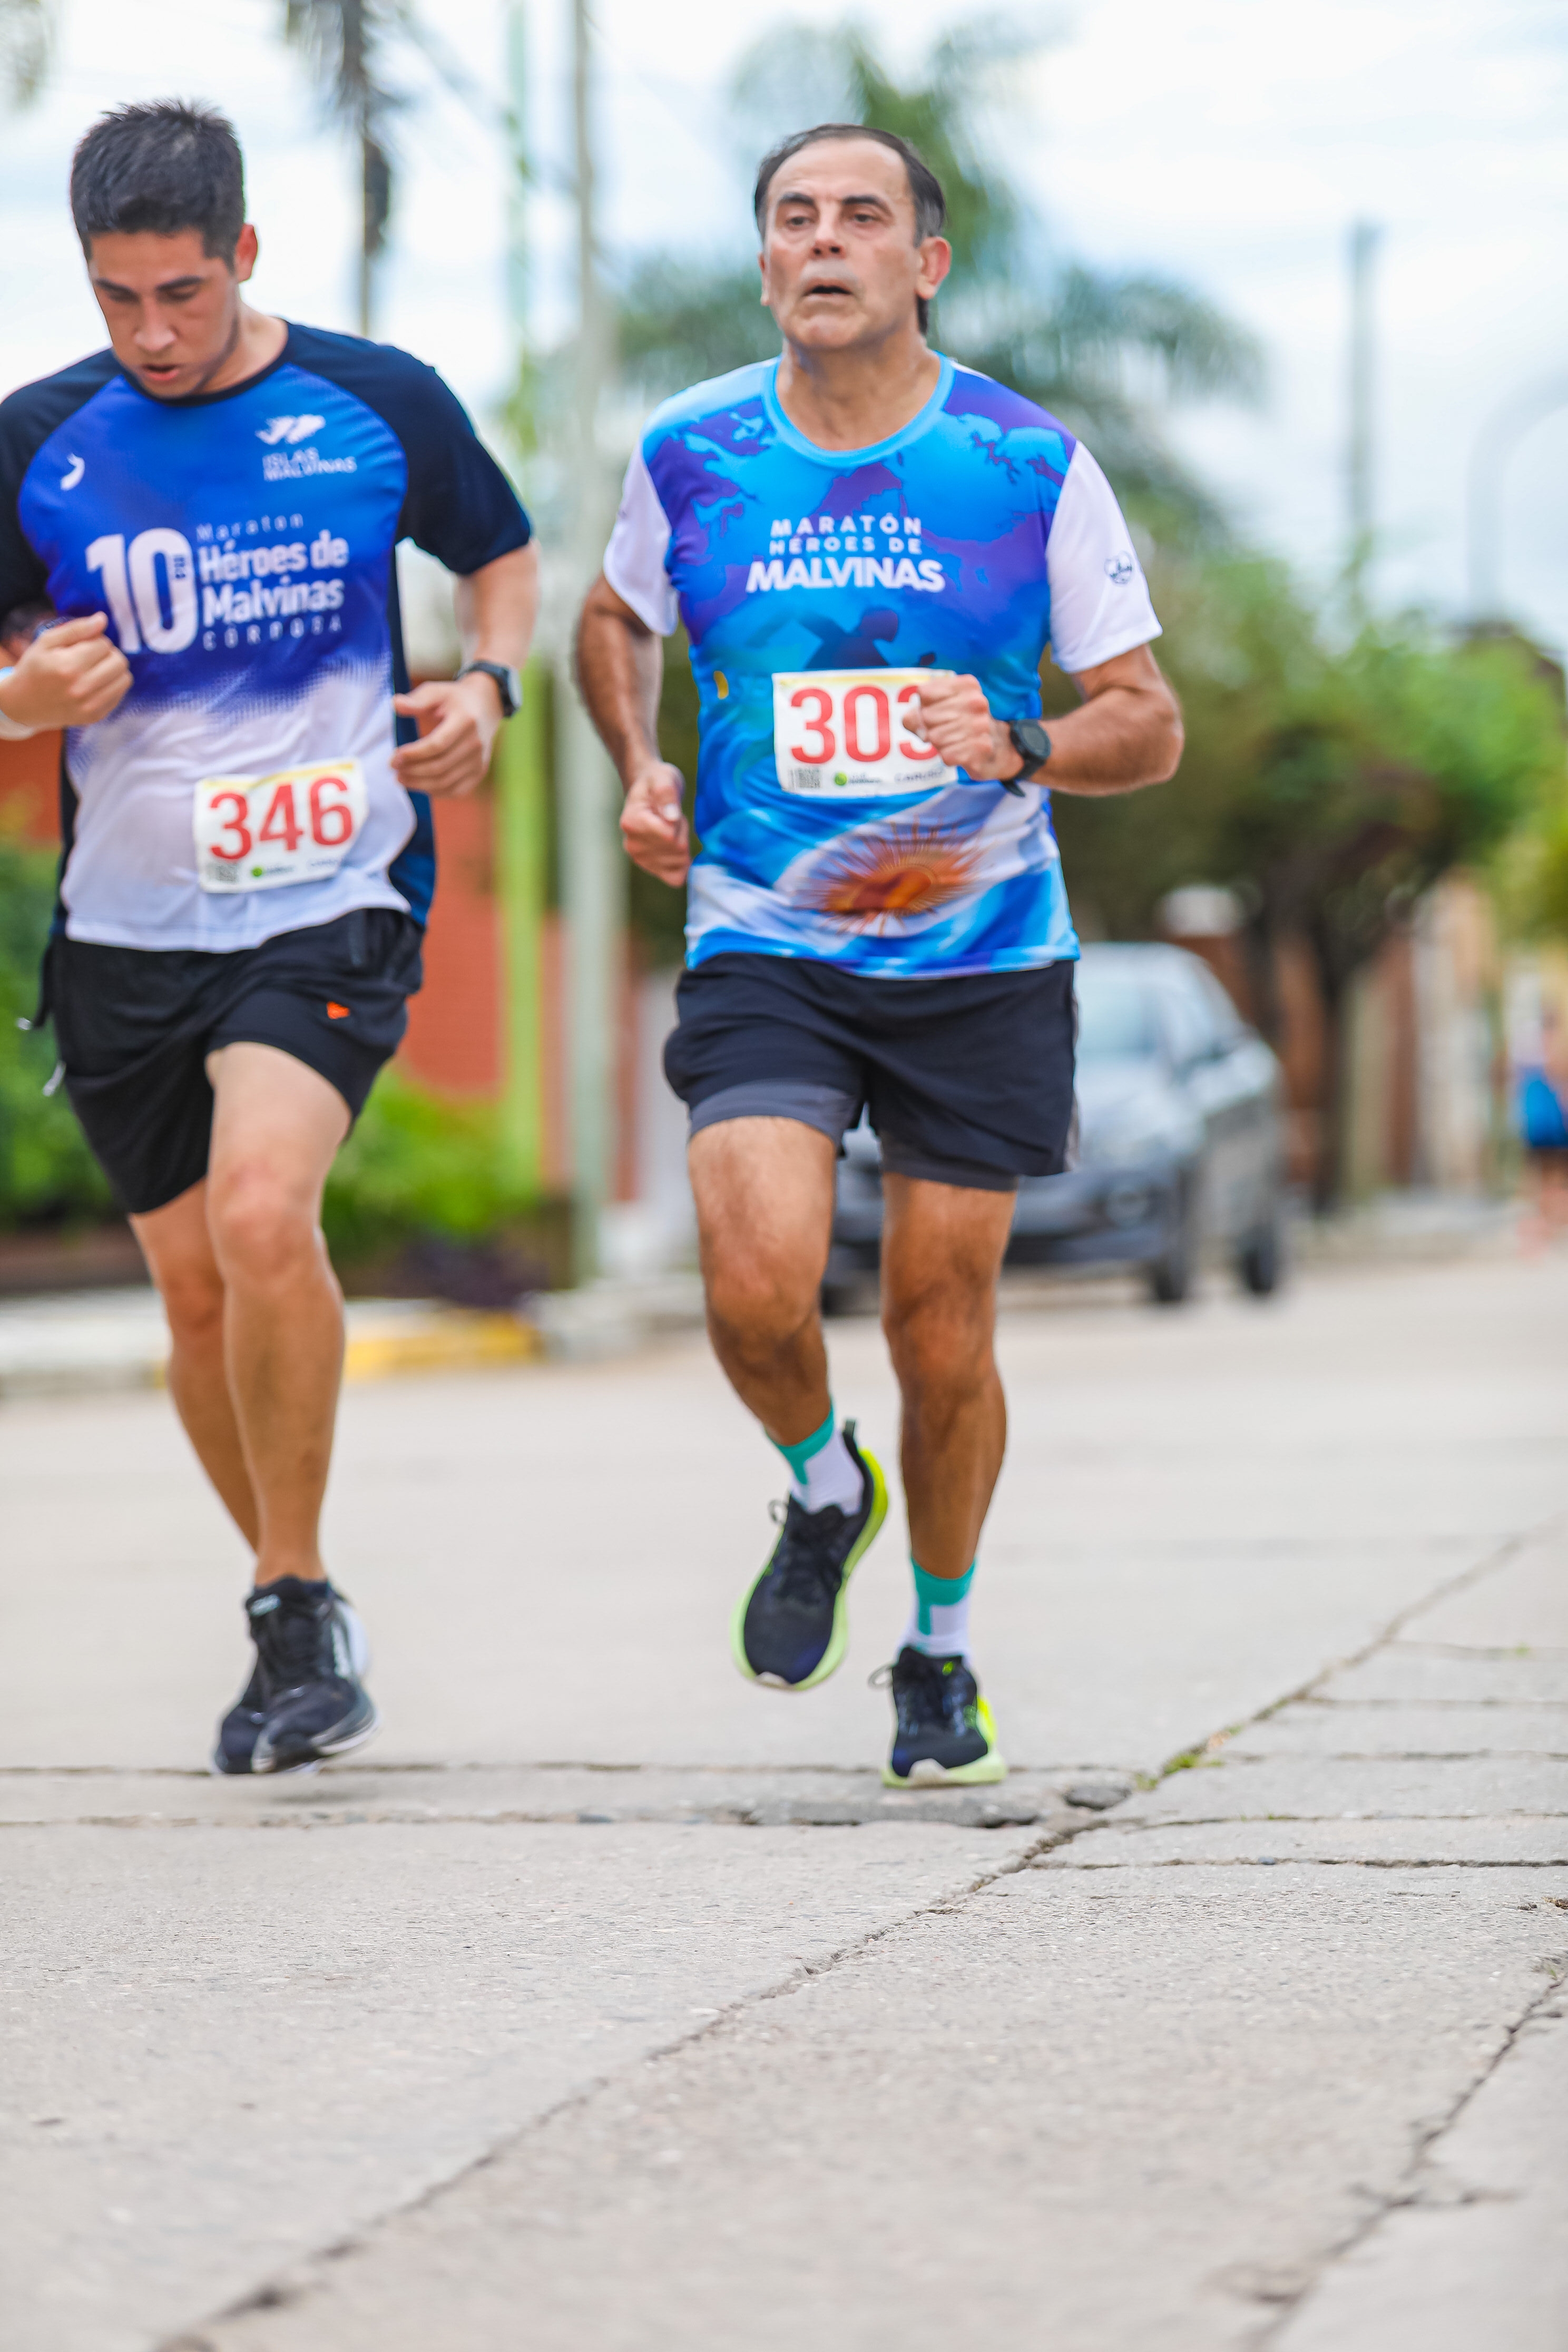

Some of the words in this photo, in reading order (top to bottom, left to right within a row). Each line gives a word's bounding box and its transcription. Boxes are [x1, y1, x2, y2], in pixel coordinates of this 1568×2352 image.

[770, 513, 922, 538] MARATÓN
[889, 537, 922, 555] DE
[198, 538, 308, 583] Héroes
[310, 529, 349, 569] de
[746, 557, 946, 593] MALVINAS
[86, 527, 199, 654] 10
[203, 574, 345, 627] Malvinas
[210, 777, 354, 860] 346
